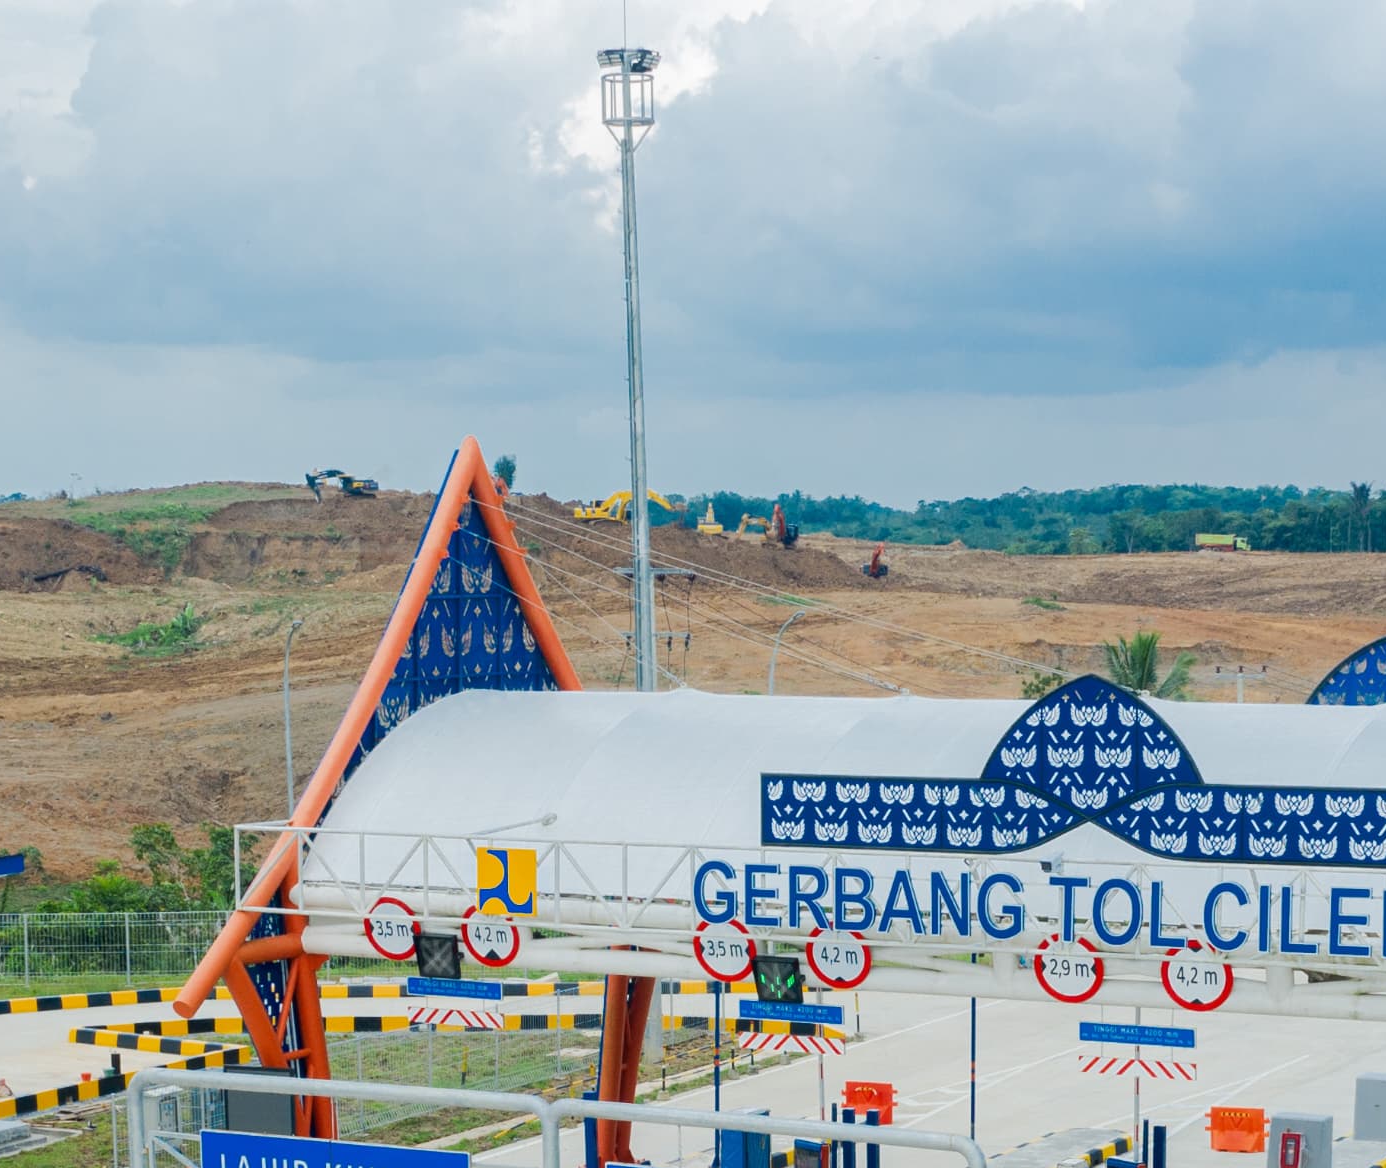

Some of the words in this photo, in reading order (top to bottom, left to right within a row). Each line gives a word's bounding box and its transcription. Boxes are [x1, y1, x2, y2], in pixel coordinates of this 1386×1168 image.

[693, 860, 1025, 941] GERBANG
[1049, 876, 1188, 949] TOL
[376, 920, 394, 938] 3,5
[397, 922, 409, 937] m
[474, 926, 492, 944] 4,2
[496, 929, 508, 944] m
[707, 940, 726, 957] 3,5
[730, 942, 743, 957] m
[820, 946, 841, 966] 4,2
[845, 950, 858, 965] m
[1049, 958, 1071, 979] 2,9
[1075, 962, 1090, 977] m
[1176, 966, 1198, 987] 4,2
[1204, 970, 1218, 985] m
